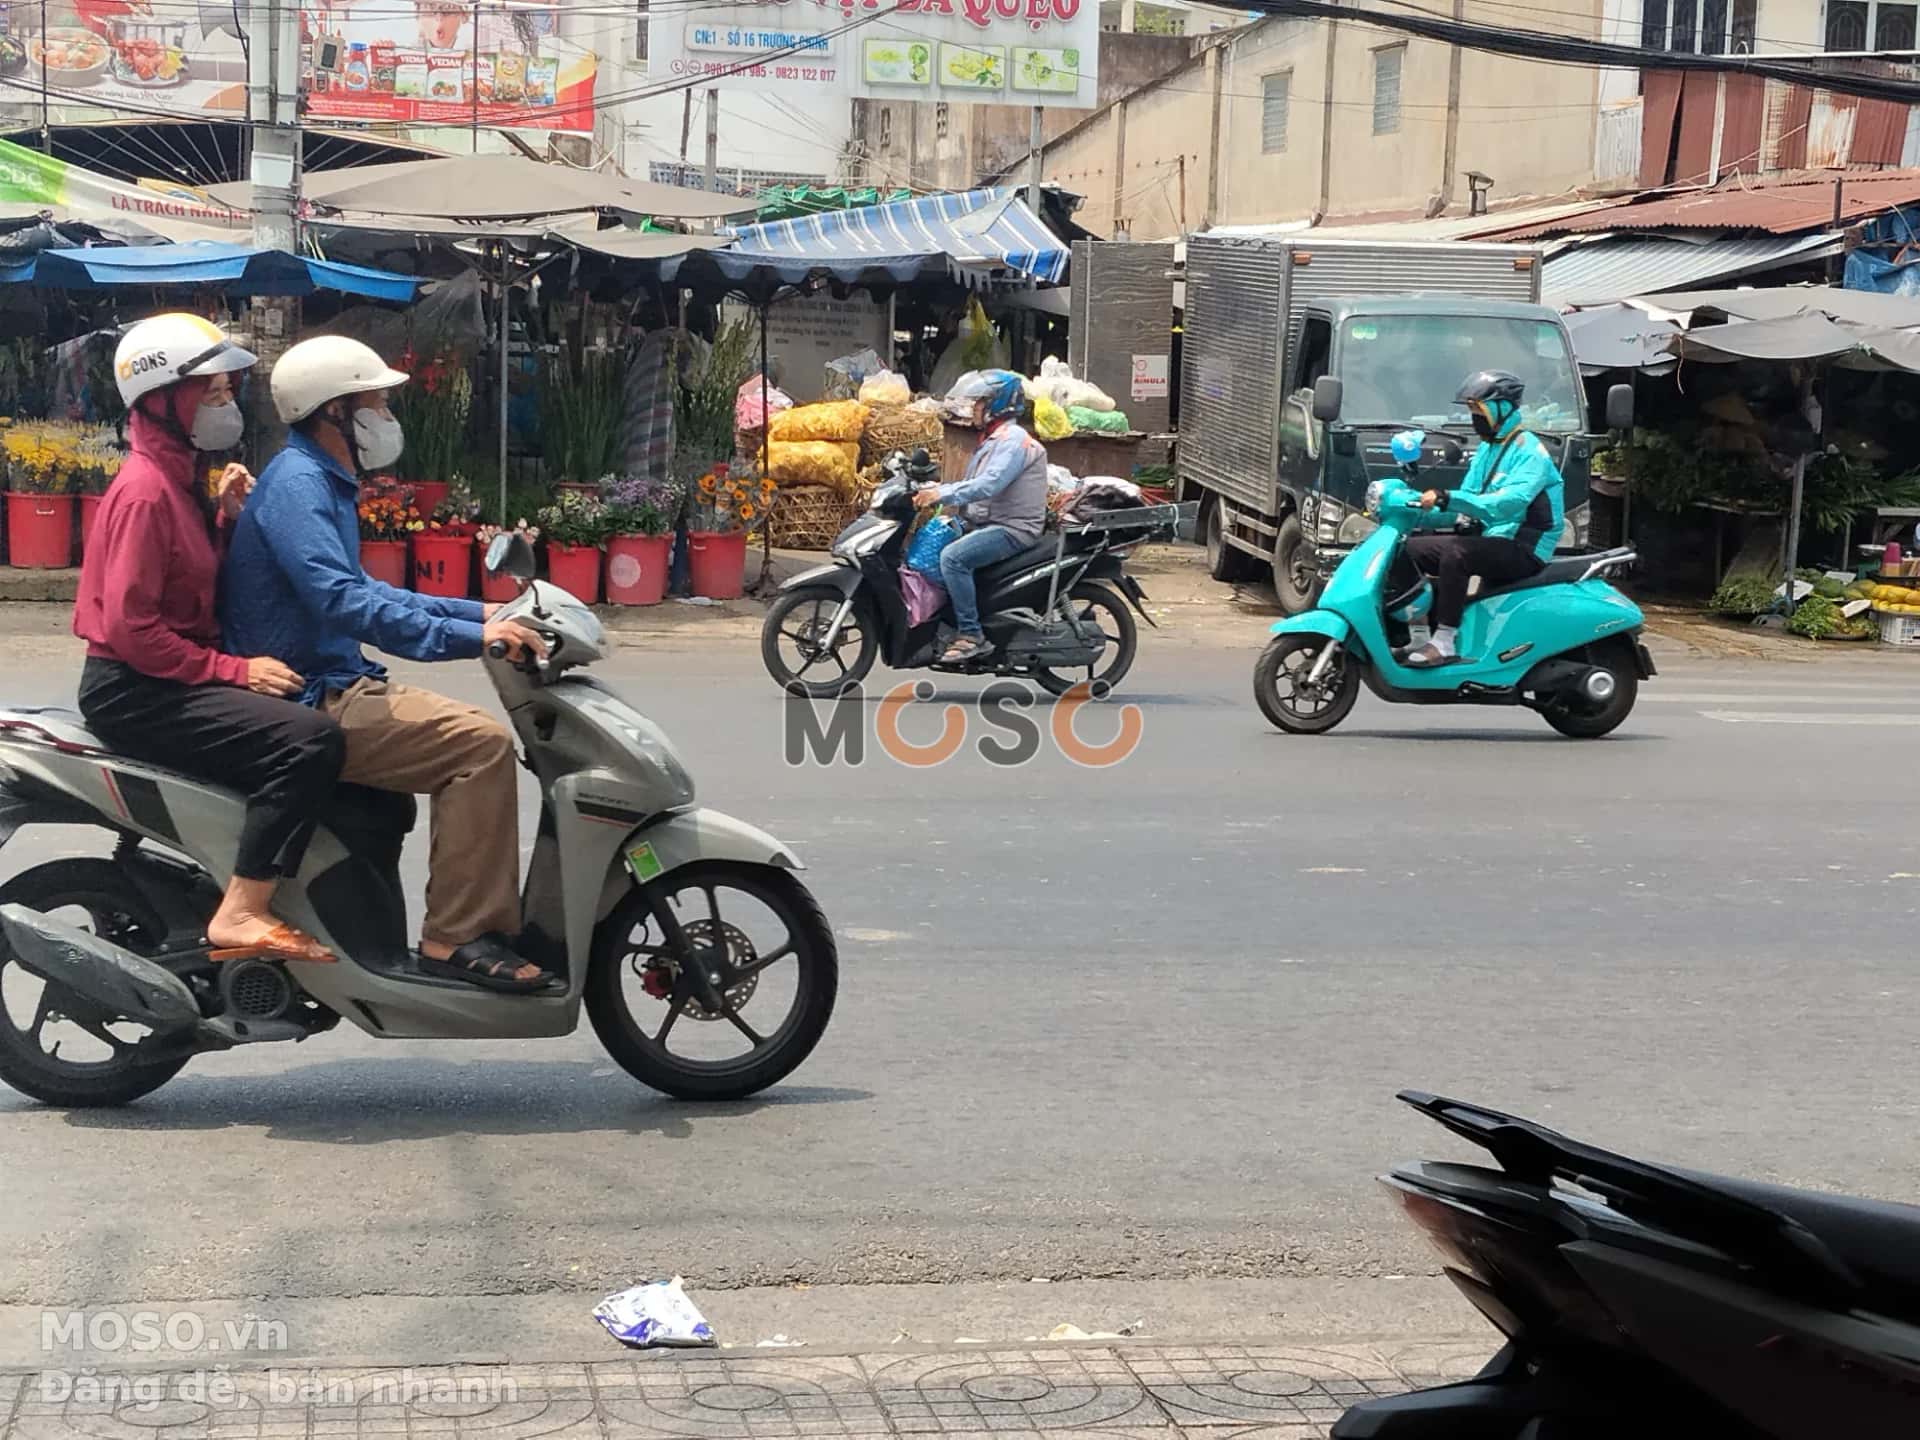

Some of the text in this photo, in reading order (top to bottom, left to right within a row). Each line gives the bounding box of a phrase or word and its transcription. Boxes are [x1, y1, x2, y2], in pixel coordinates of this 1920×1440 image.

[695, 30, 716, 45] CN:1
[744, 32, 755, 47] 16
[776, 67, 798, 79] 0823
[802, 69, 817, 80] 122
[820, 69, 836, 81] 017
